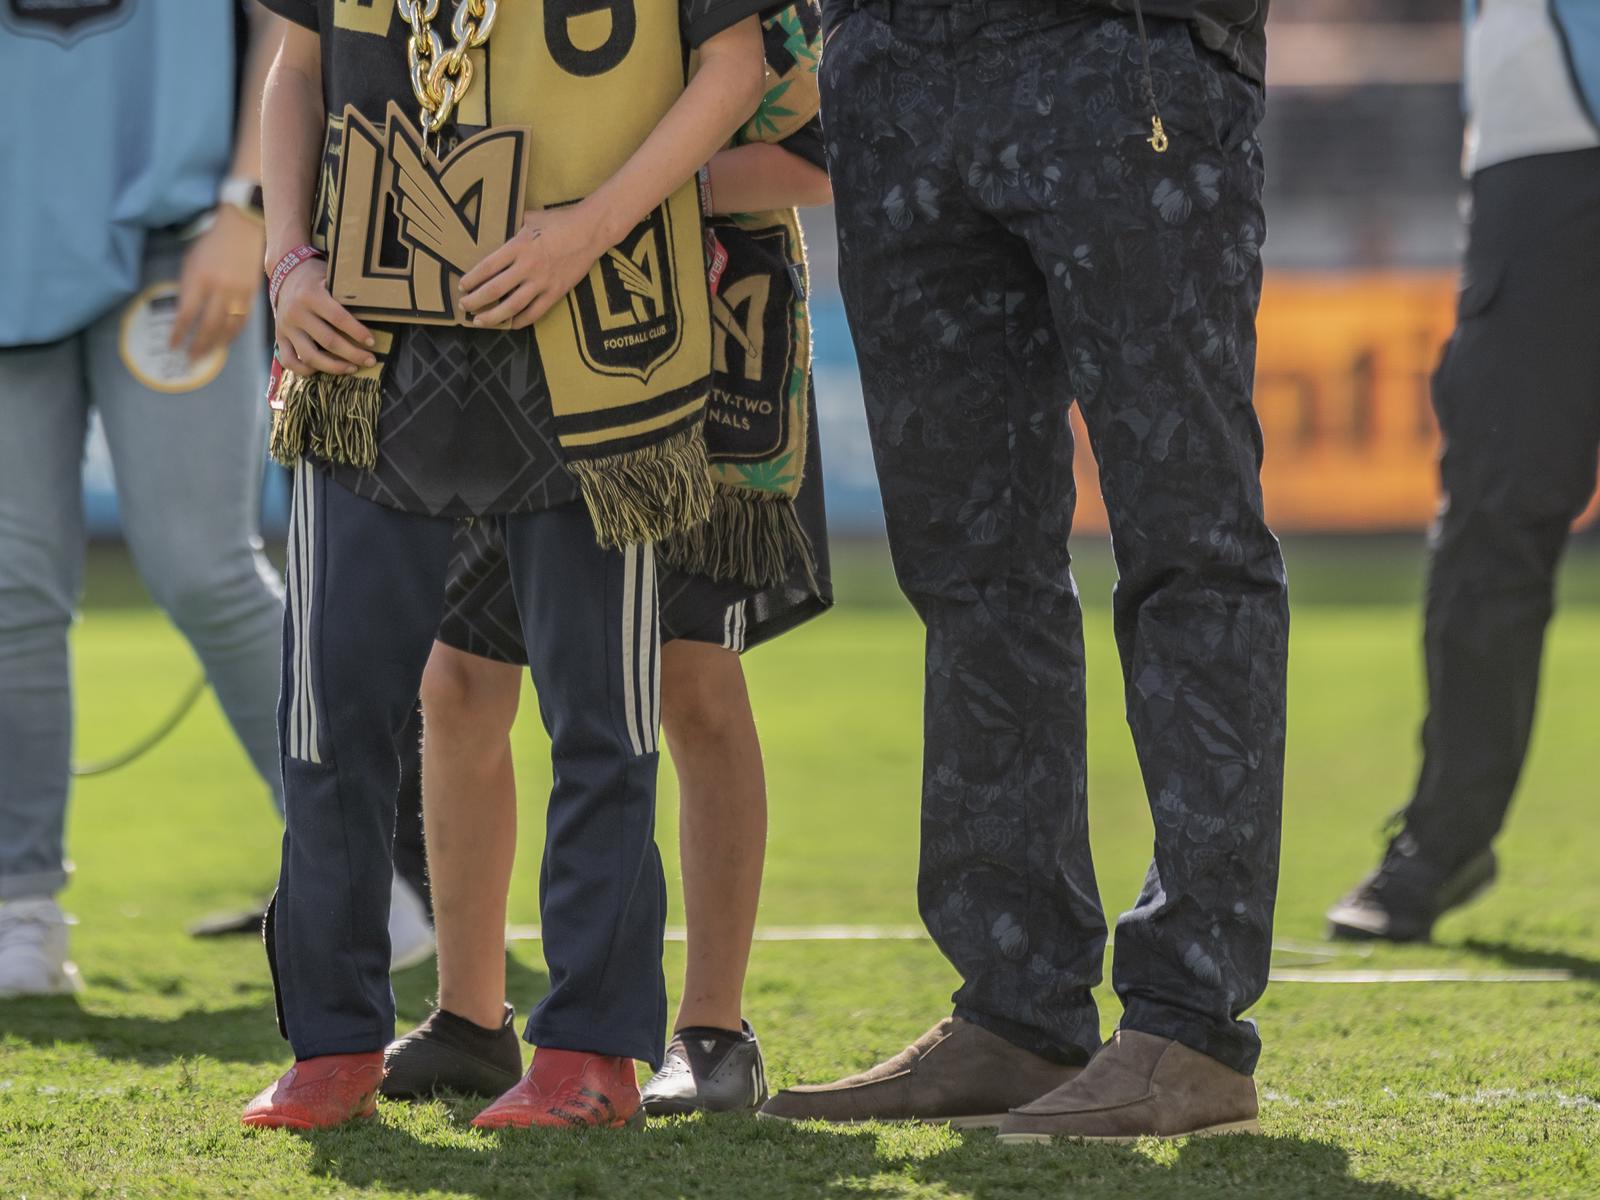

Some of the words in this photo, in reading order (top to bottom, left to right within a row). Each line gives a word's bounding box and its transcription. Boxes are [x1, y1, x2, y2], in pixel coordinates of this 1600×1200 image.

[709, 252, 725, 282] FIELD
[603, 334, 648, 350] FOOTBALL
[649, 325, 667, 339] CLUB
[711, 389, 772, 414] TY-TWO
